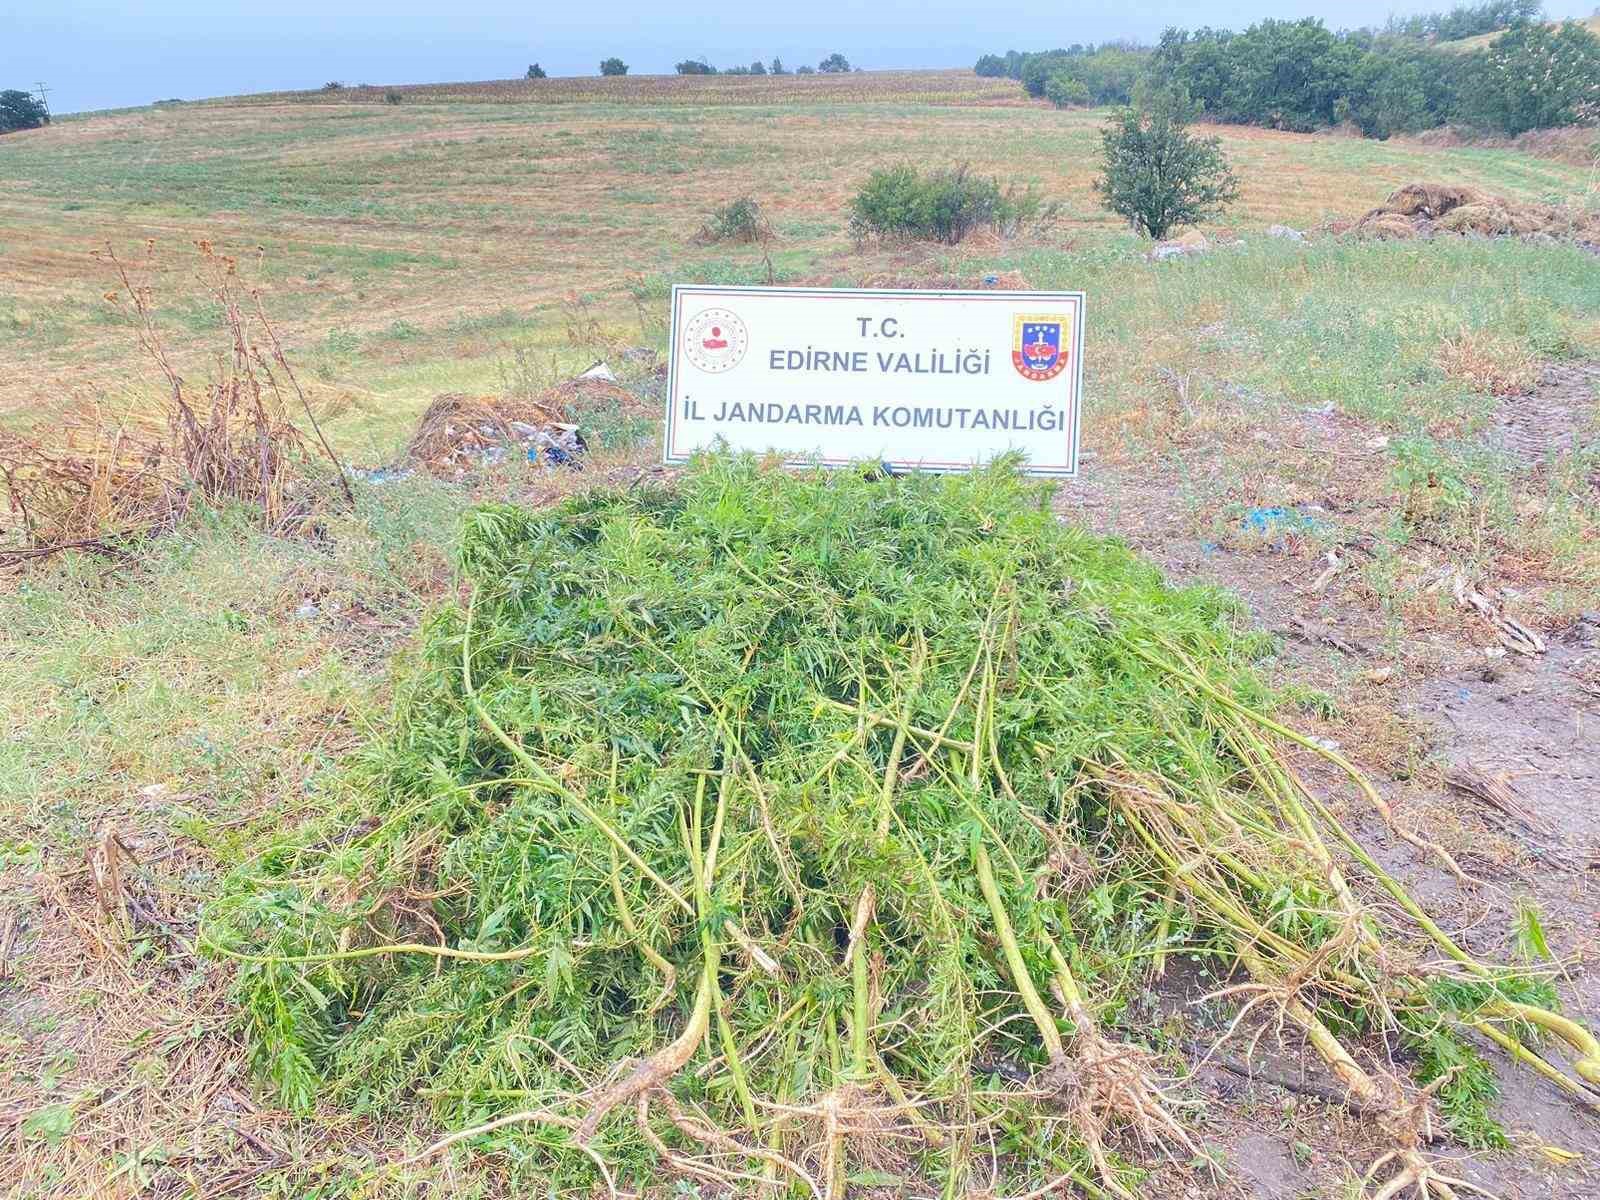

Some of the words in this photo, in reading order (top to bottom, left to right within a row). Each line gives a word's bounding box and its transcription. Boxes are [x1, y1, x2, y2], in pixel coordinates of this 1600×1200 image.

[857, 317, 906, 339] T.C.
[770, 345, 868, 373] EDİRNE
[877, 348, 991, 375] VALİLİĞİ
[684, 395, 706, 421] İL
[713, 402, 864, 427] JANDARMA
[873, 406, 1066, 431] KOMUTANLIĞI
